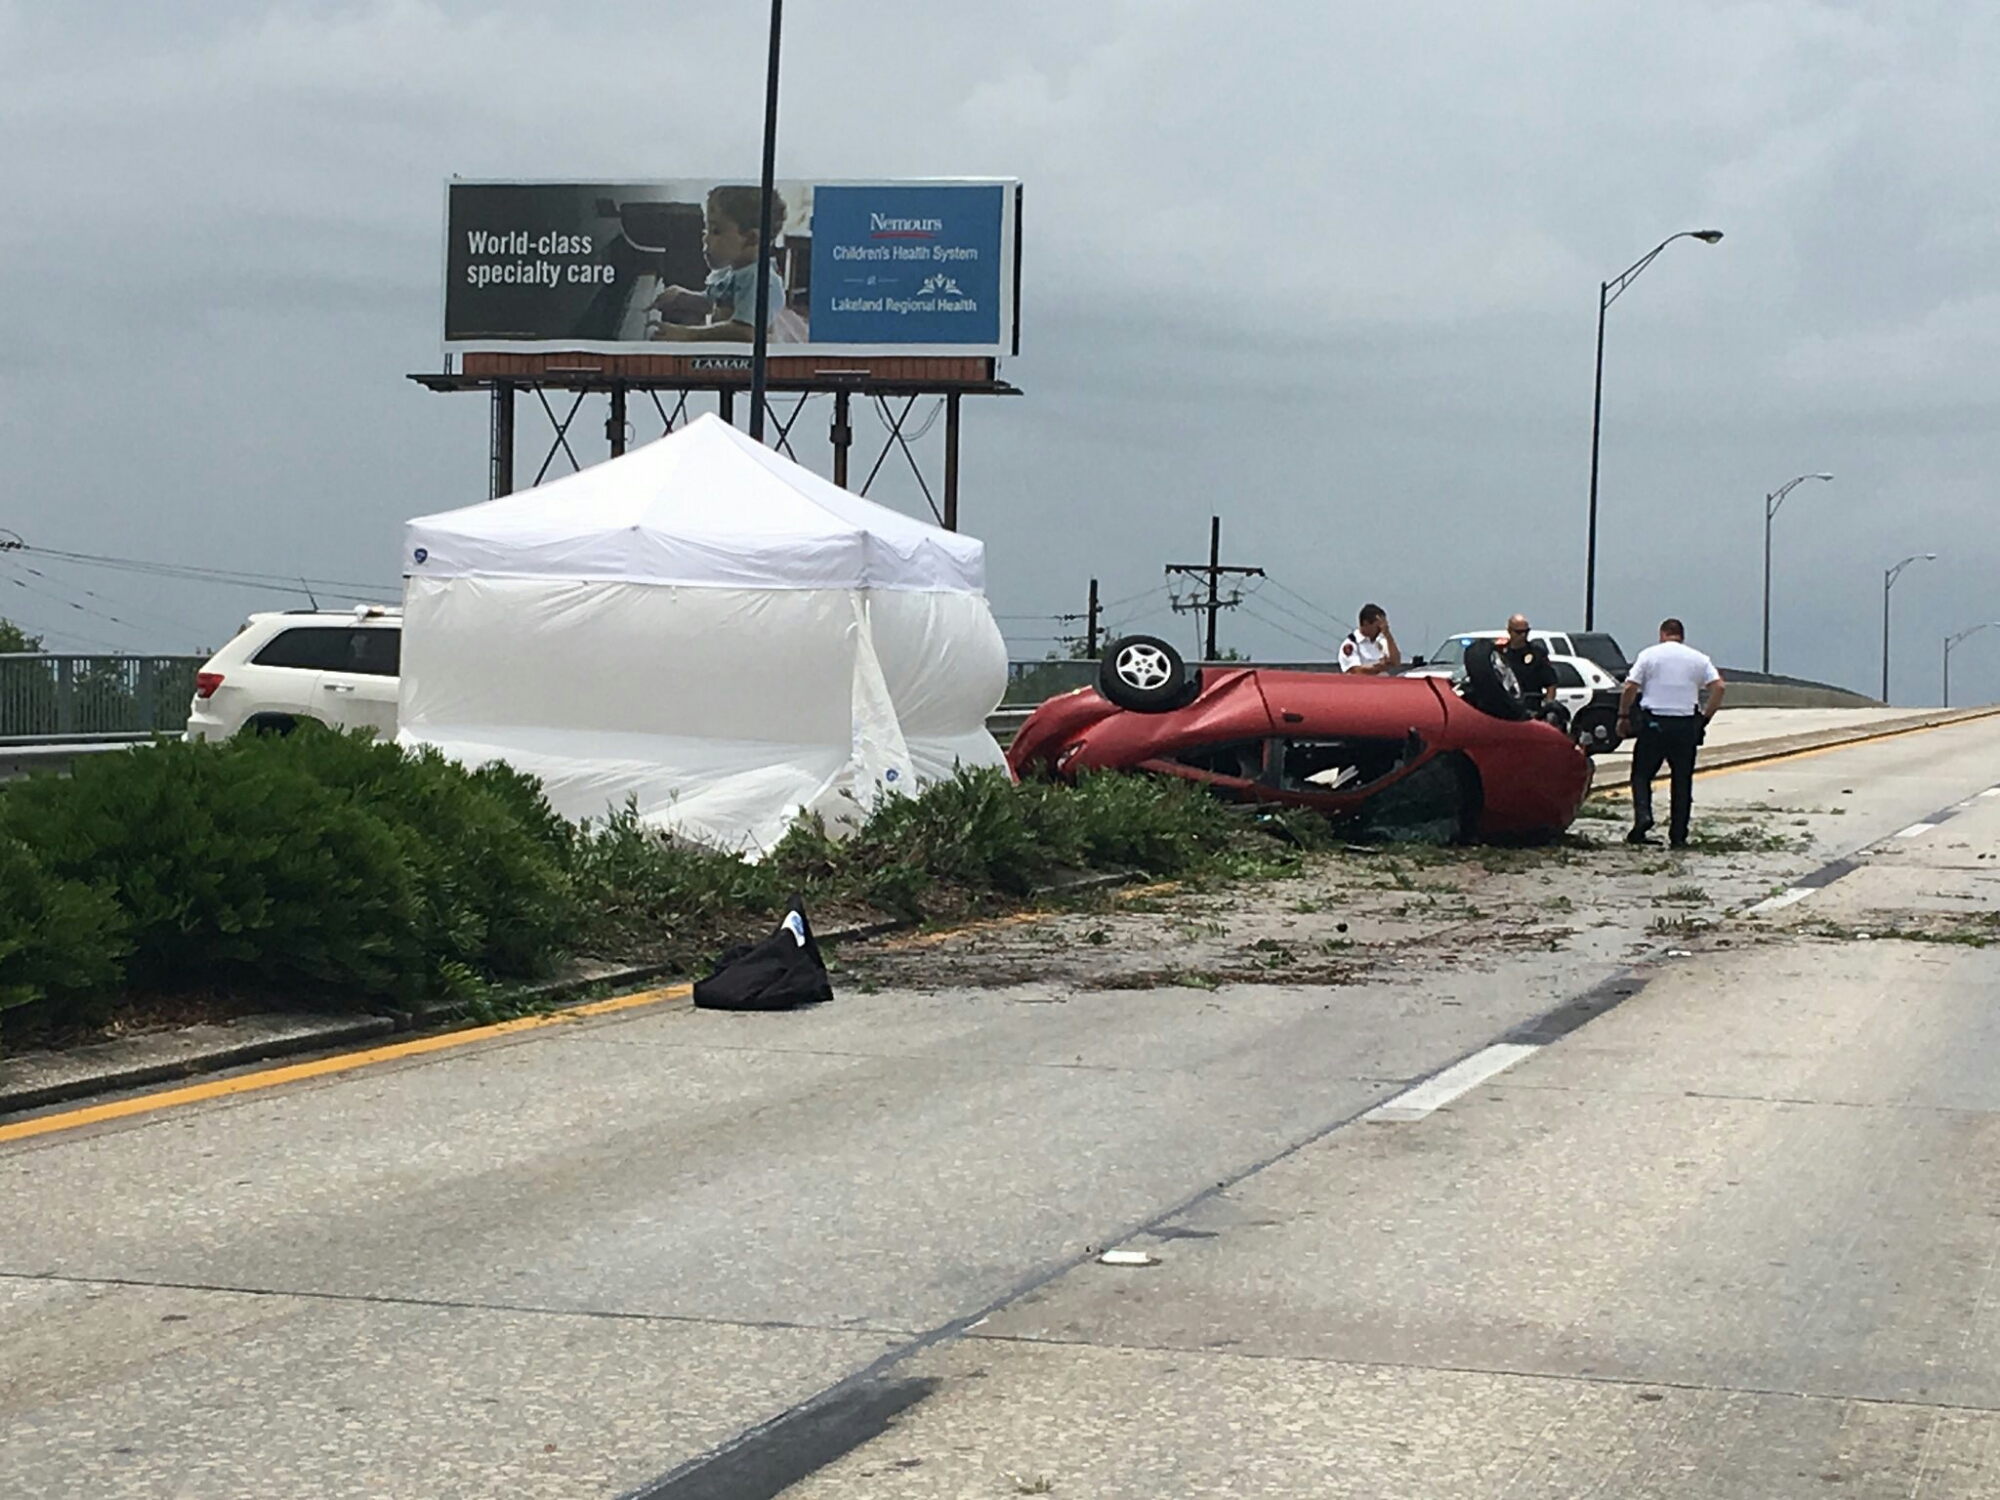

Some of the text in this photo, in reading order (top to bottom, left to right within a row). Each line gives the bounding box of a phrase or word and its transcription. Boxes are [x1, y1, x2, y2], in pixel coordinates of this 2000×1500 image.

[870, 212, 942, 231] Nemours
[467, 230, 593, 255] World-class
[833, 245, 978, 263] Children's Health System
[467, 260, 615, 288] specialty care
[831, 297, 977, 315] Lakeland Regional Health
